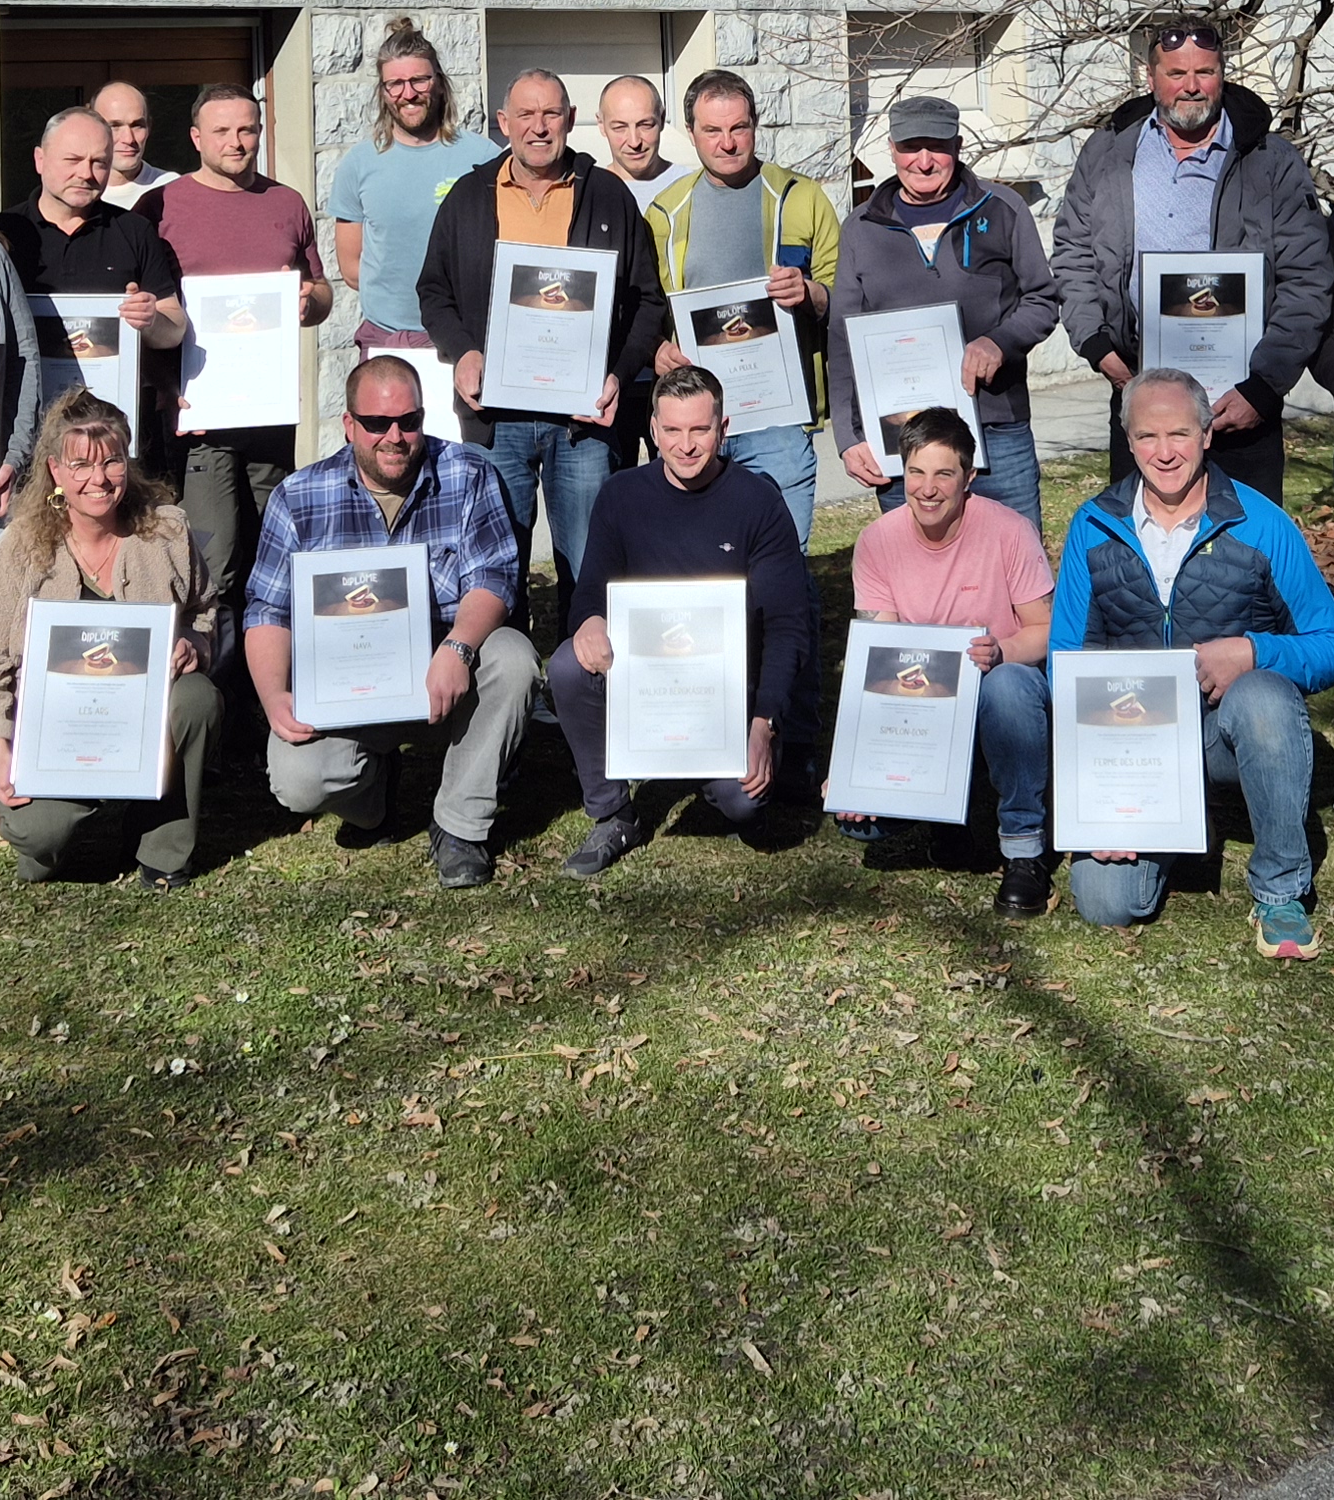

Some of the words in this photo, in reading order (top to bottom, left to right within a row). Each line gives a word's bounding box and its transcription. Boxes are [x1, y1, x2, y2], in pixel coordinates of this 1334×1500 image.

[538, 269, 572, 283] DIPLÔME
[1186, 275, 1220, 288] DIPLÔME
[716, 305, 748, 319] DIPLÔME
[342, 573, 378, 586] DIPLÔME
[81, 628, 120, 643] DIPLÔME
[898, 652, 930, 665] DIPLOM
[1107, 678, 1146, 693] DIPLÔME
[1093, 757, 1119, 767] FERME
[1120, 757, 1134, 767] DES
